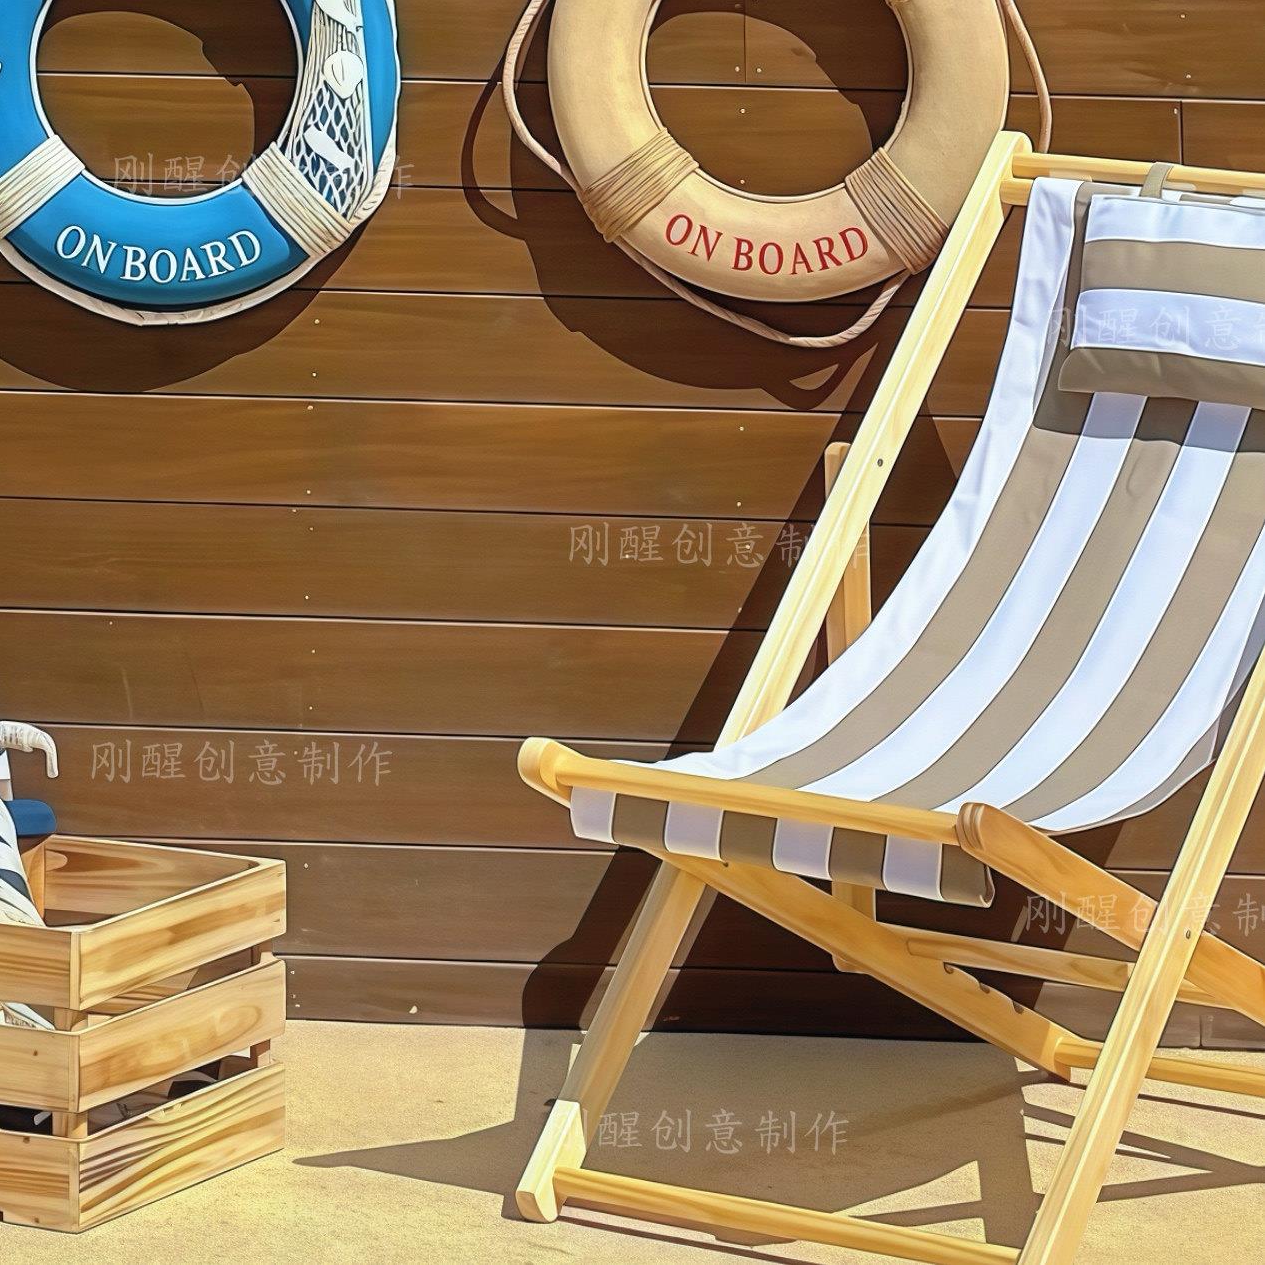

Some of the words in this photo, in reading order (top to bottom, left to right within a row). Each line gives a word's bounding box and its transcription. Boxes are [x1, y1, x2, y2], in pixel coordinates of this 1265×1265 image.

[55, 225, 118, 274] ON
[120, 230, 262, 284] BOARD
[665, 214, 723, 262] ON
[731, 227, 868, 275] BOARD
